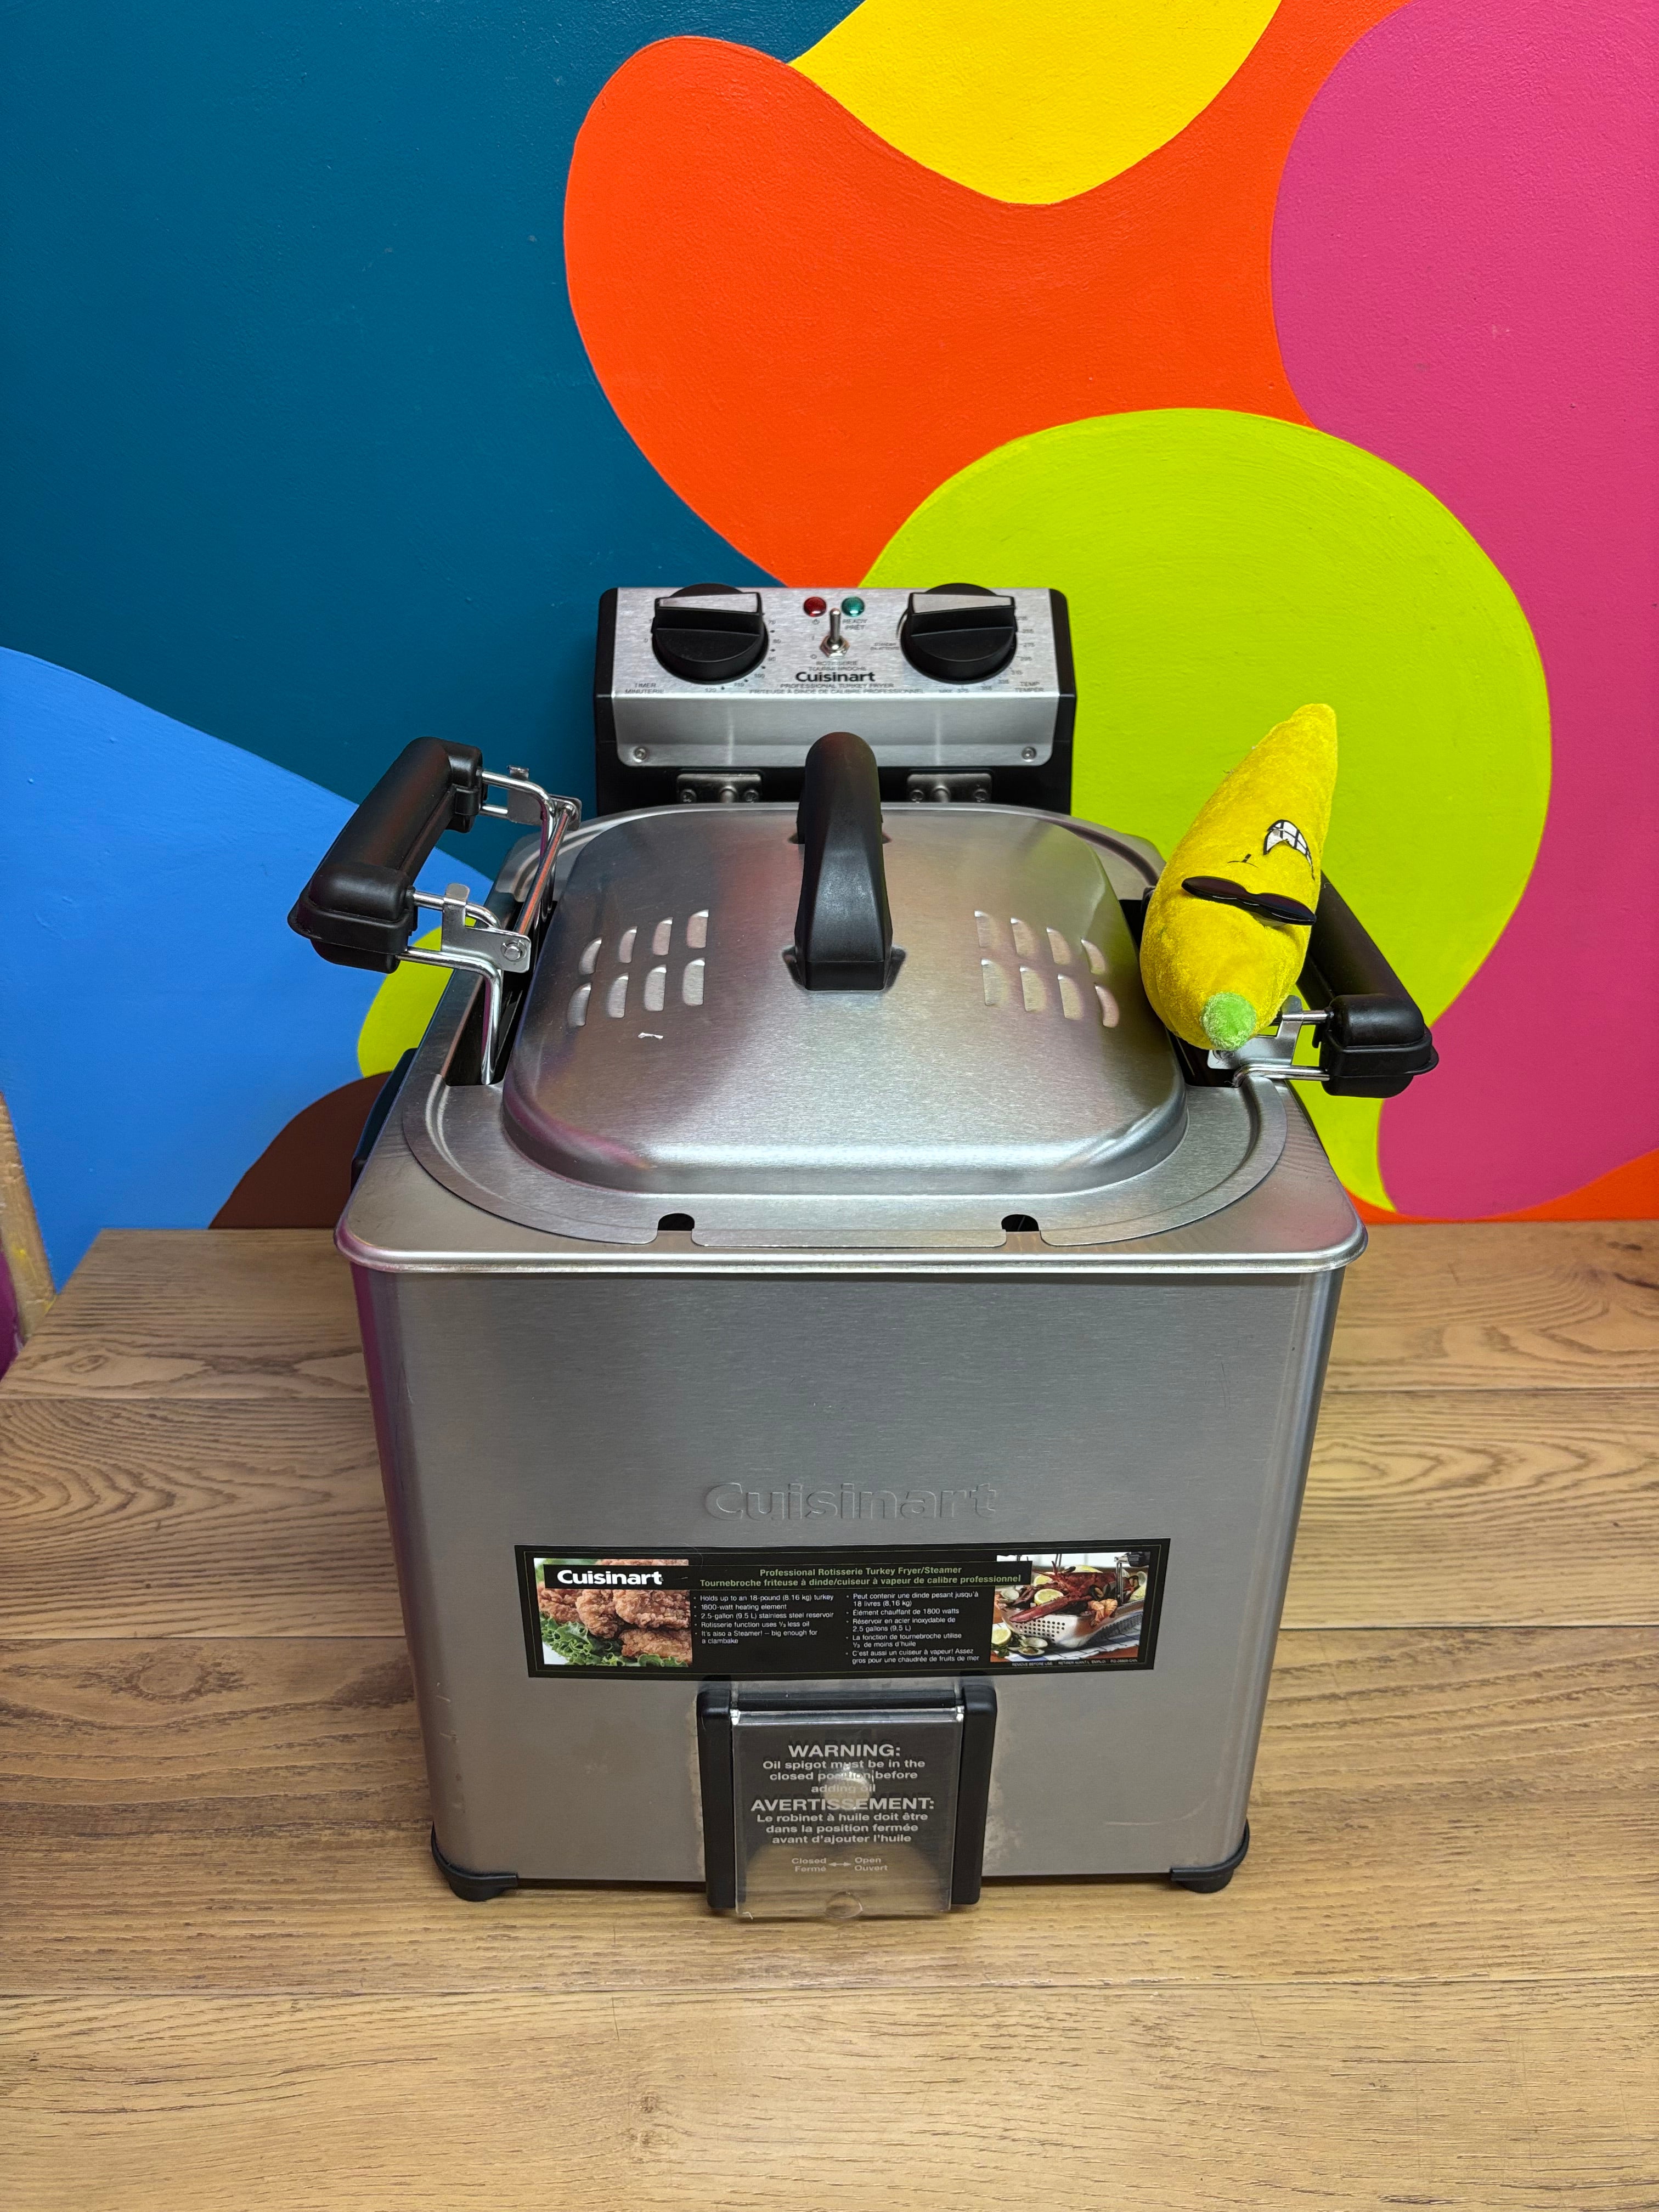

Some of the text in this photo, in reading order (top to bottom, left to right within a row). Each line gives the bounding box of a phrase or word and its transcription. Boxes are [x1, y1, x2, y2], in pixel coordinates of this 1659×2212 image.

[795, 672, 876, 682] Cuisinart
[706, 1482, 997, 1521] Cuisinart
[818, 1568, 863, 1576] Rotisserie
[866, 1567, 895, 1576] Turkey
[898, 1566, 962, 1576] Fryer/Steamer
[809, 1578, 870, 1586] dinde/cuiseur
[873, 1577, 878, 1585] à
[927, 1575, 958, 1583] calibre
[960, 1575, 1021, 1584] professionnel
[788, 1744, 900, 1757] WARNING:
[785, 1760, 826, 1771] spigot
[868, 1759, 884, 1768] be
[888, 1759, 900, 1768] in
[904, 1759, 926, 1768] the
[769, 1772, 814, 1780] closed
[875, 1771, 918, 1779] before
[811, 1784, 876, 1793] adding oil
[751, 1797, 934, 1811] AVERTISSEMENT:
[757, 1814, 772, 1822] Le
[776, 1814, 823, 1822] robinet
[827, 1813, 834, 1821] à
[838, 1813, 870, 1821] huile
[873, 1812, 899, 1821] doit
[766, 1825, 798, 1833] dans
[802, 1825, 812, 1833] la
[816, 1824, 868, 1835] position
[772, 1836, 808, 1844] avant
[811, 1835, 870, 1845] d'ajouter
